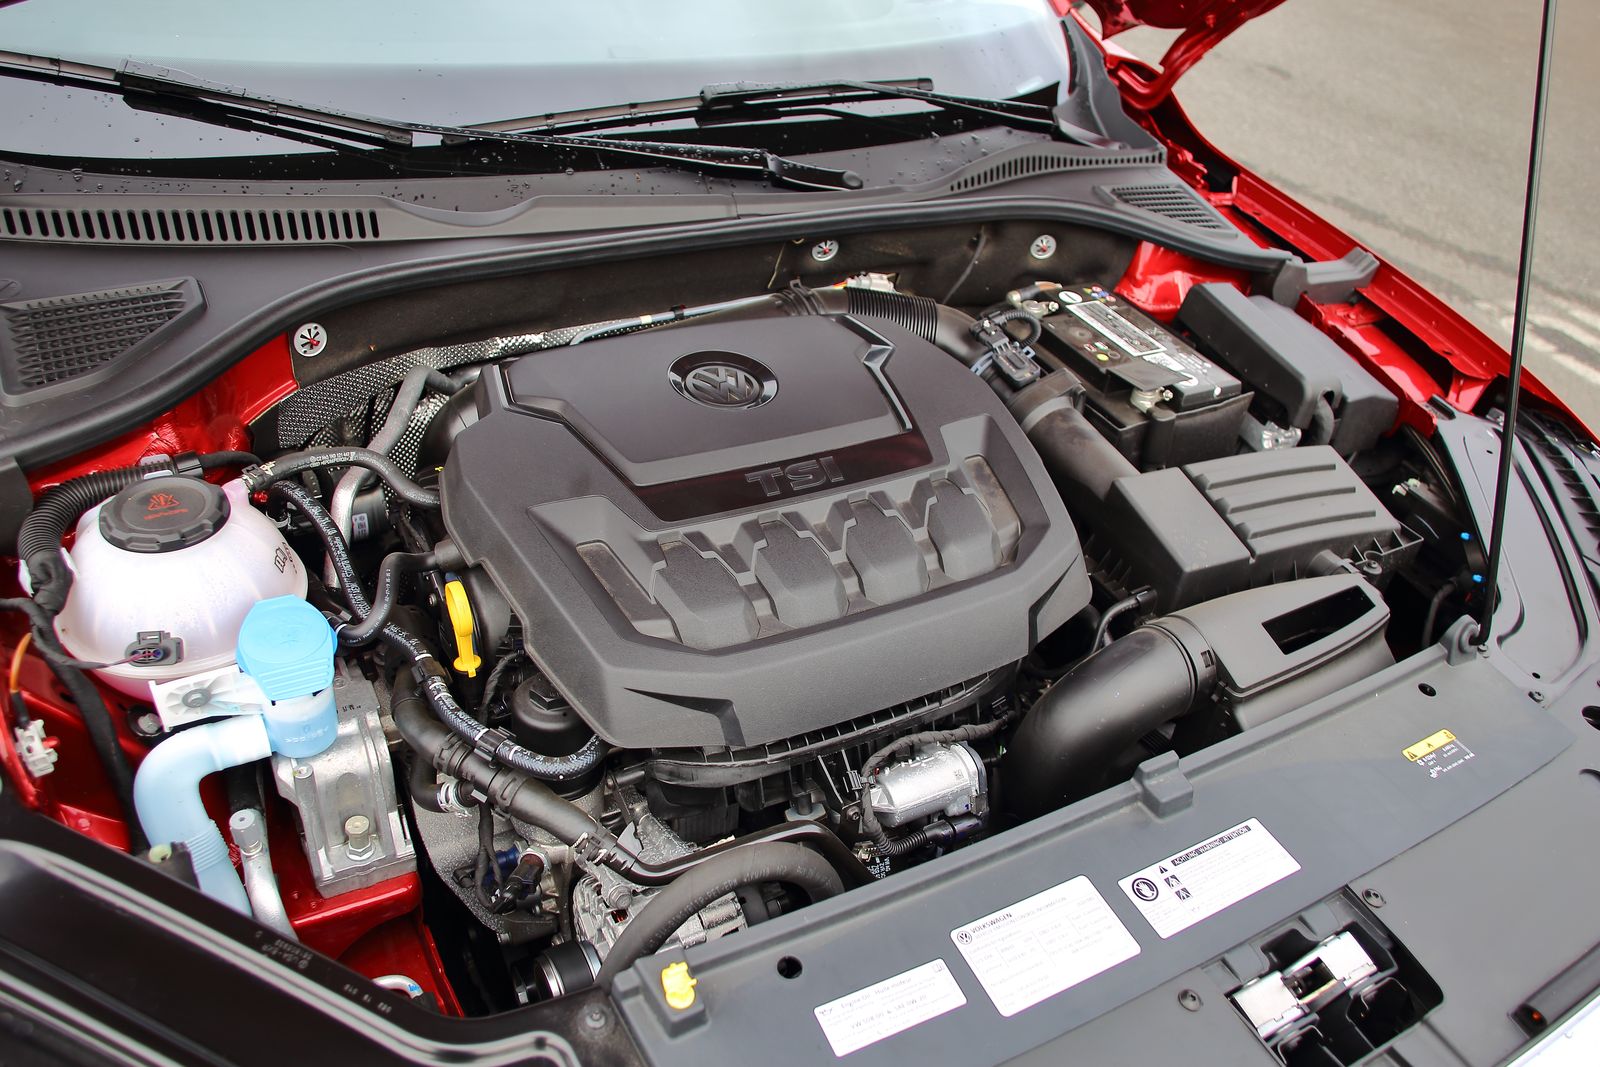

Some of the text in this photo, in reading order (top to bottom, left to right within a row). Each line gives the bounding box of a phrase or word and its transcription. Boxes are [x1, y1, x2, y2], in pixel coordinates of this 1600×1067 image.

[744, 455, 845, 497] TSI
[1174, 827, 1248, 865] ACHTUNG WARNING ATTENTION
[970, 912, 1012, 933] VOLKSWAGEN
